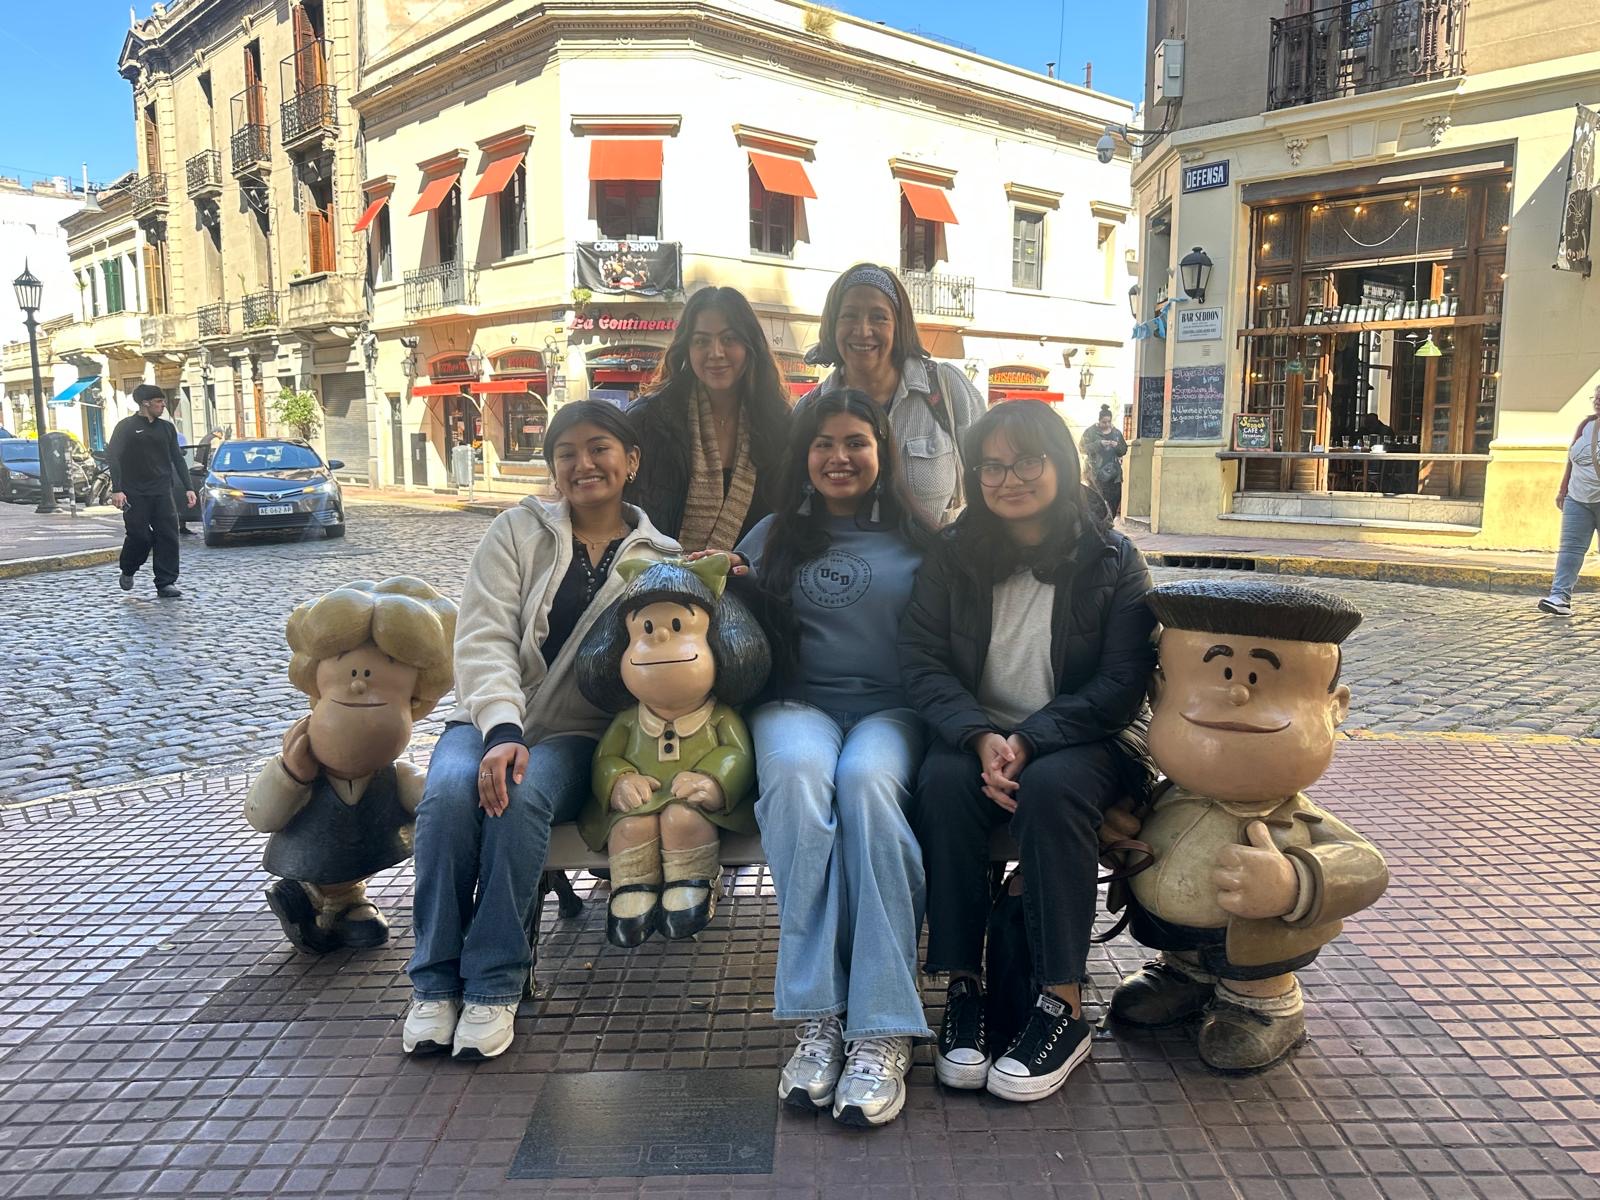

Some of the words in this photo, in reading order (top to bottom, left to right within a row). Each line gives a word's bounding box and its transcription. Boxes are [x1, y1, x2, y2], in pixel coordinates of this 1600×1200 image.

[1186, 165, 1224, 188] DEFENSA
[593, 242, 618, 252] CENA
[630, 242, 659, 252] SHOW
[1181, 312, 1194, 323] BAR
[1195, 310, 1219, 322] SEDDON
[820, 568, 850, 586] UCD
